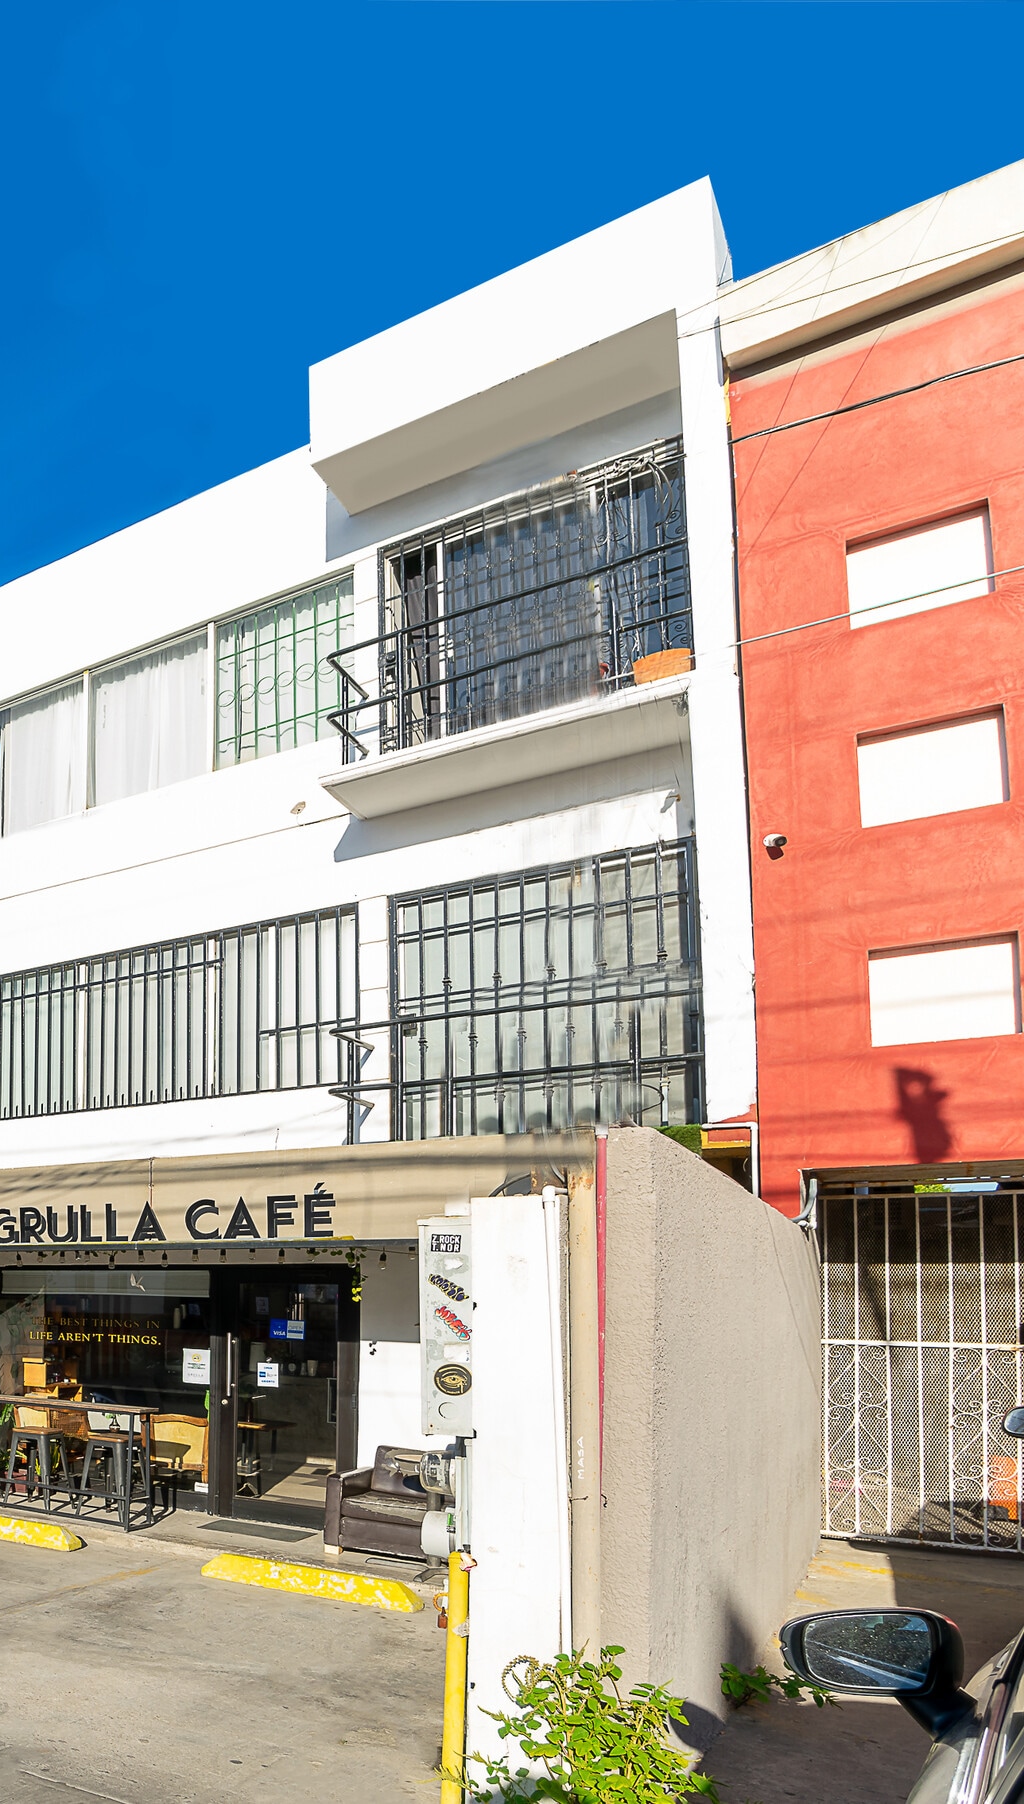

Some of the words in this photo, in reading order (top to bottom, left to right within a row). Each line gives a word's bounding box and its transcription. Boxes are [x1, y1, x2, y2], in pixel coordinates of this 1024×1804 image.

[184, 1182, 337, 1241] CAFÉ
[31, 1316, 53, 1326] THE
[59, 1316, 87, 1327] BEST
[92, 1318, 140, 1329] THINGS
[145, 1320, 160, 1330] IN
[29, 1331, 53, 1341] LIFE
[57, 1332, 104, 1343] AREN'T
[107, 1334, 162, 1346] THINGS.
[273, 1329, 286, 1337] VISA
[576, 1436, 585, 1480] MASA
